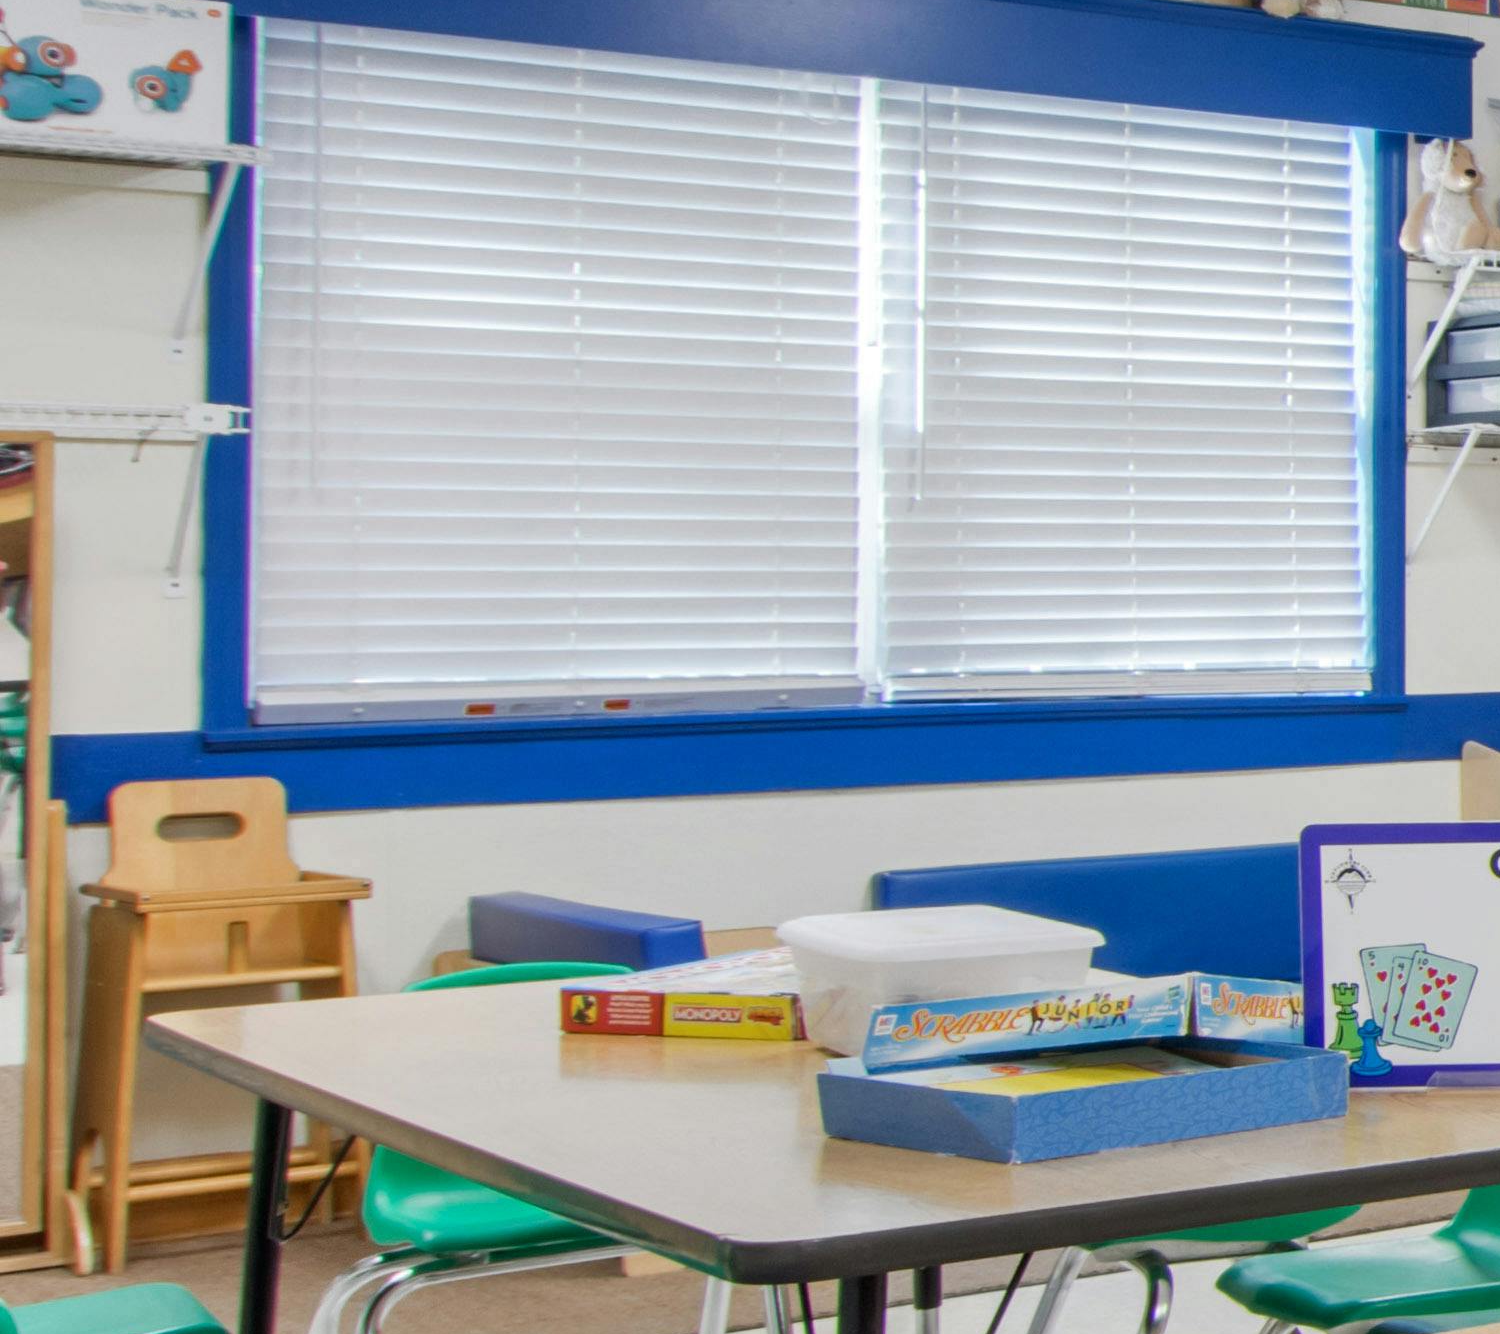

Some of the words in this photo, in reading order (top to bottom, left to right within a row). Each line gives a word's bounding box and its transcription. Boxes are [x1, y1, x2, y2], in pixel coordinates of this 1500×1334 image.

[1418, 958, 1429, 966] 10
[673, 1007, 741, 1023] MONOPOLY
[894, 1008, 1029, 1042] SCRABBLE
[1041, 999, 1128, 1022] JUNIOR
